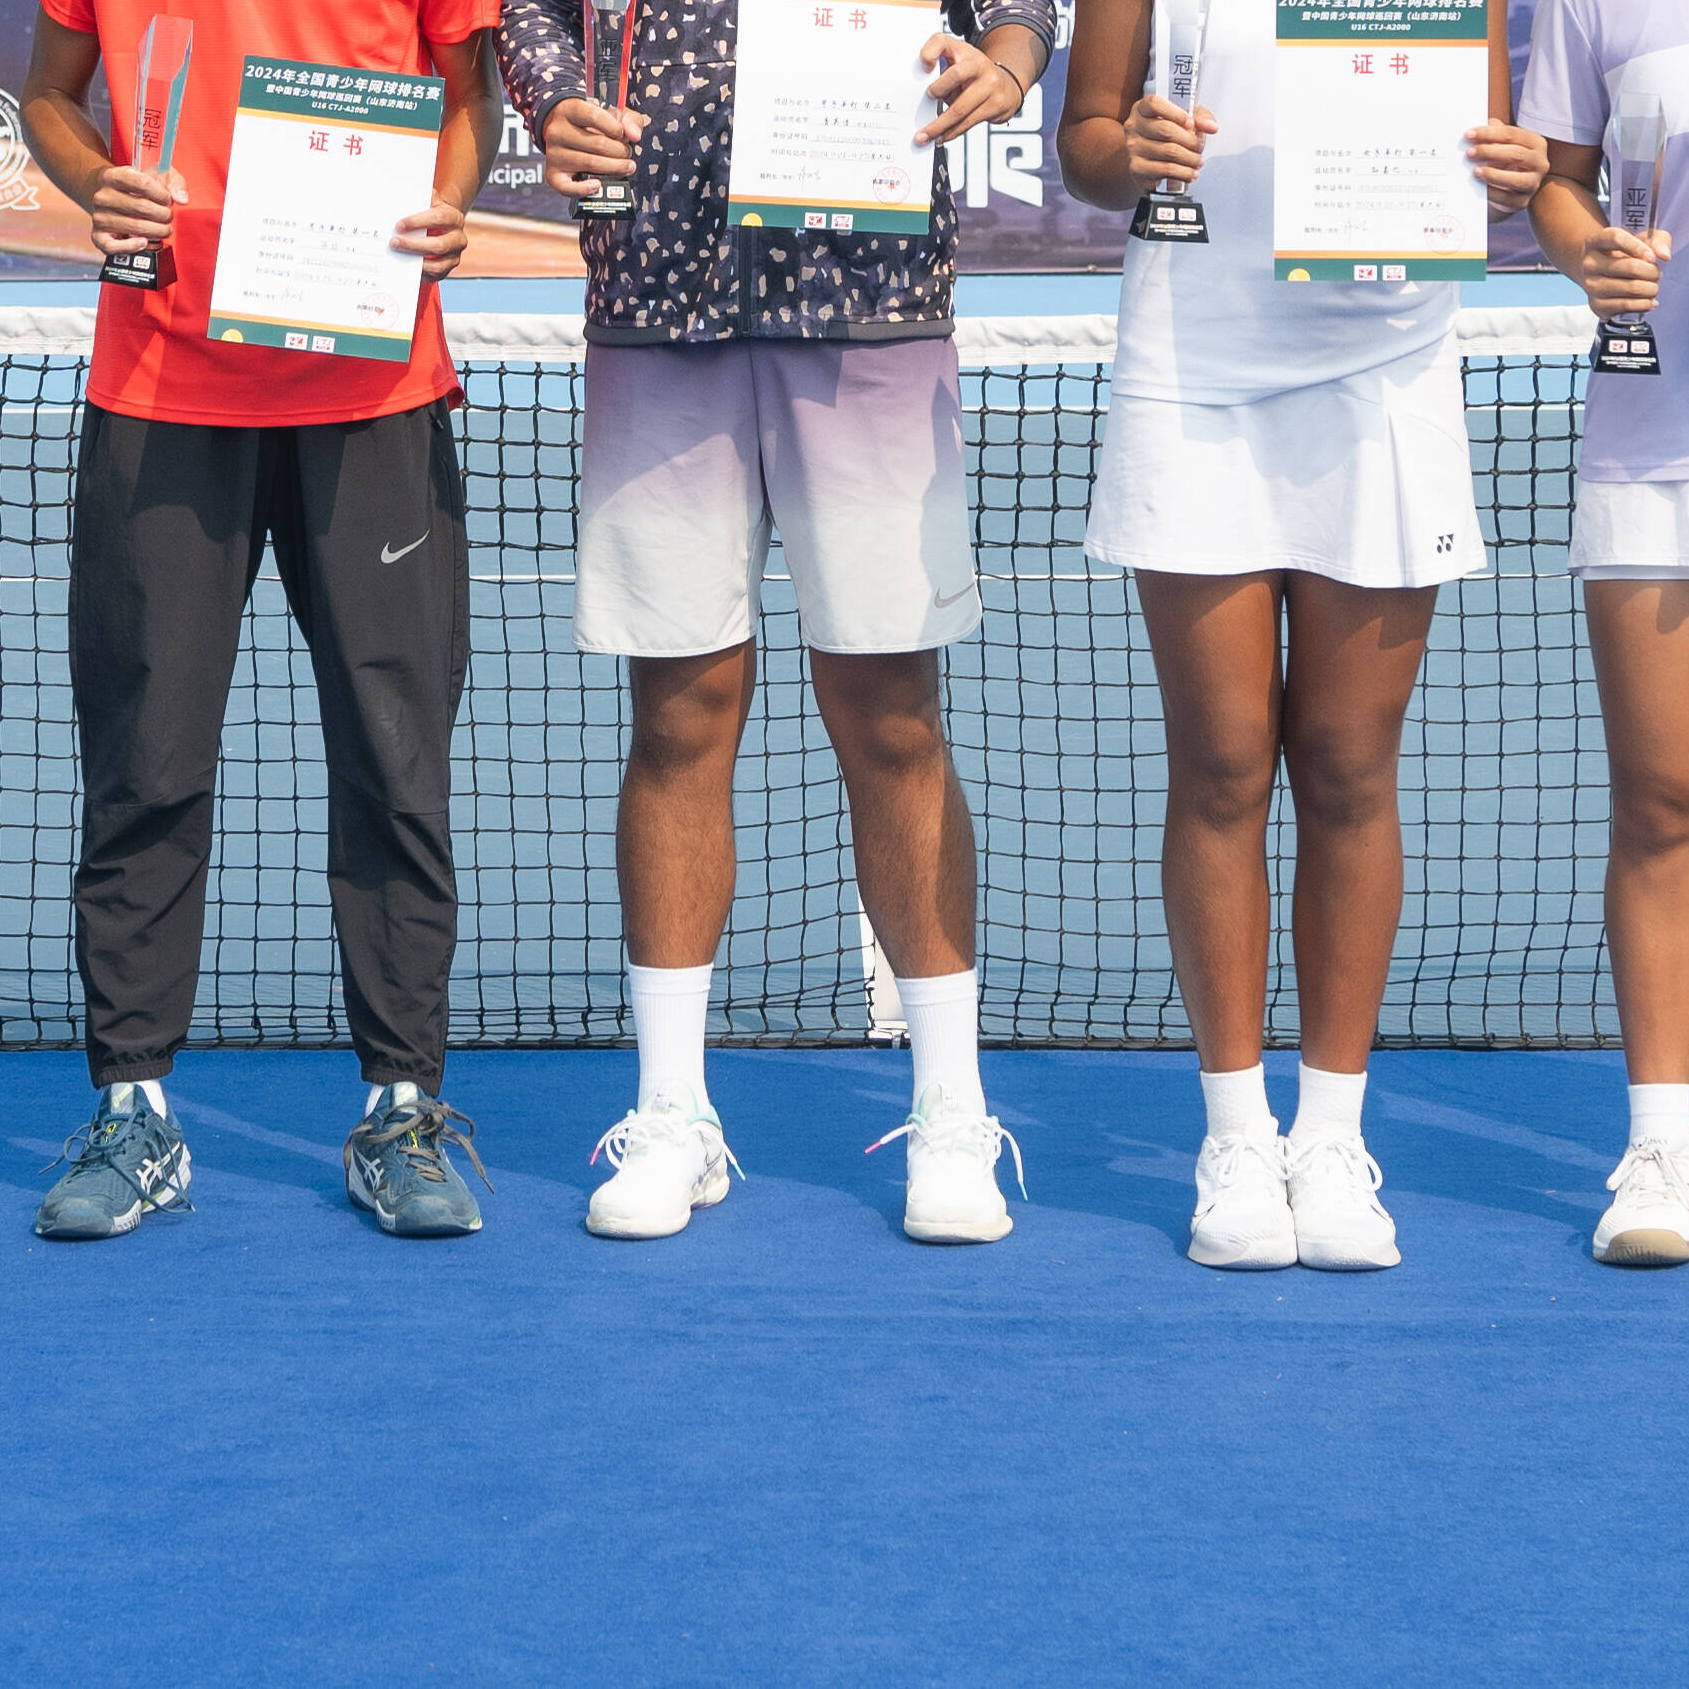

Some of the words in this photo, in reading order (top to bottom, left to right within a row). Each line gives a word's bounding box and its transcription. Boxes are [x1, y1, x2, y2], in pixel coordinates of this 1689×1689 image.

[245, 64, 441, 102] 2024年全国青少年网球排名赛
